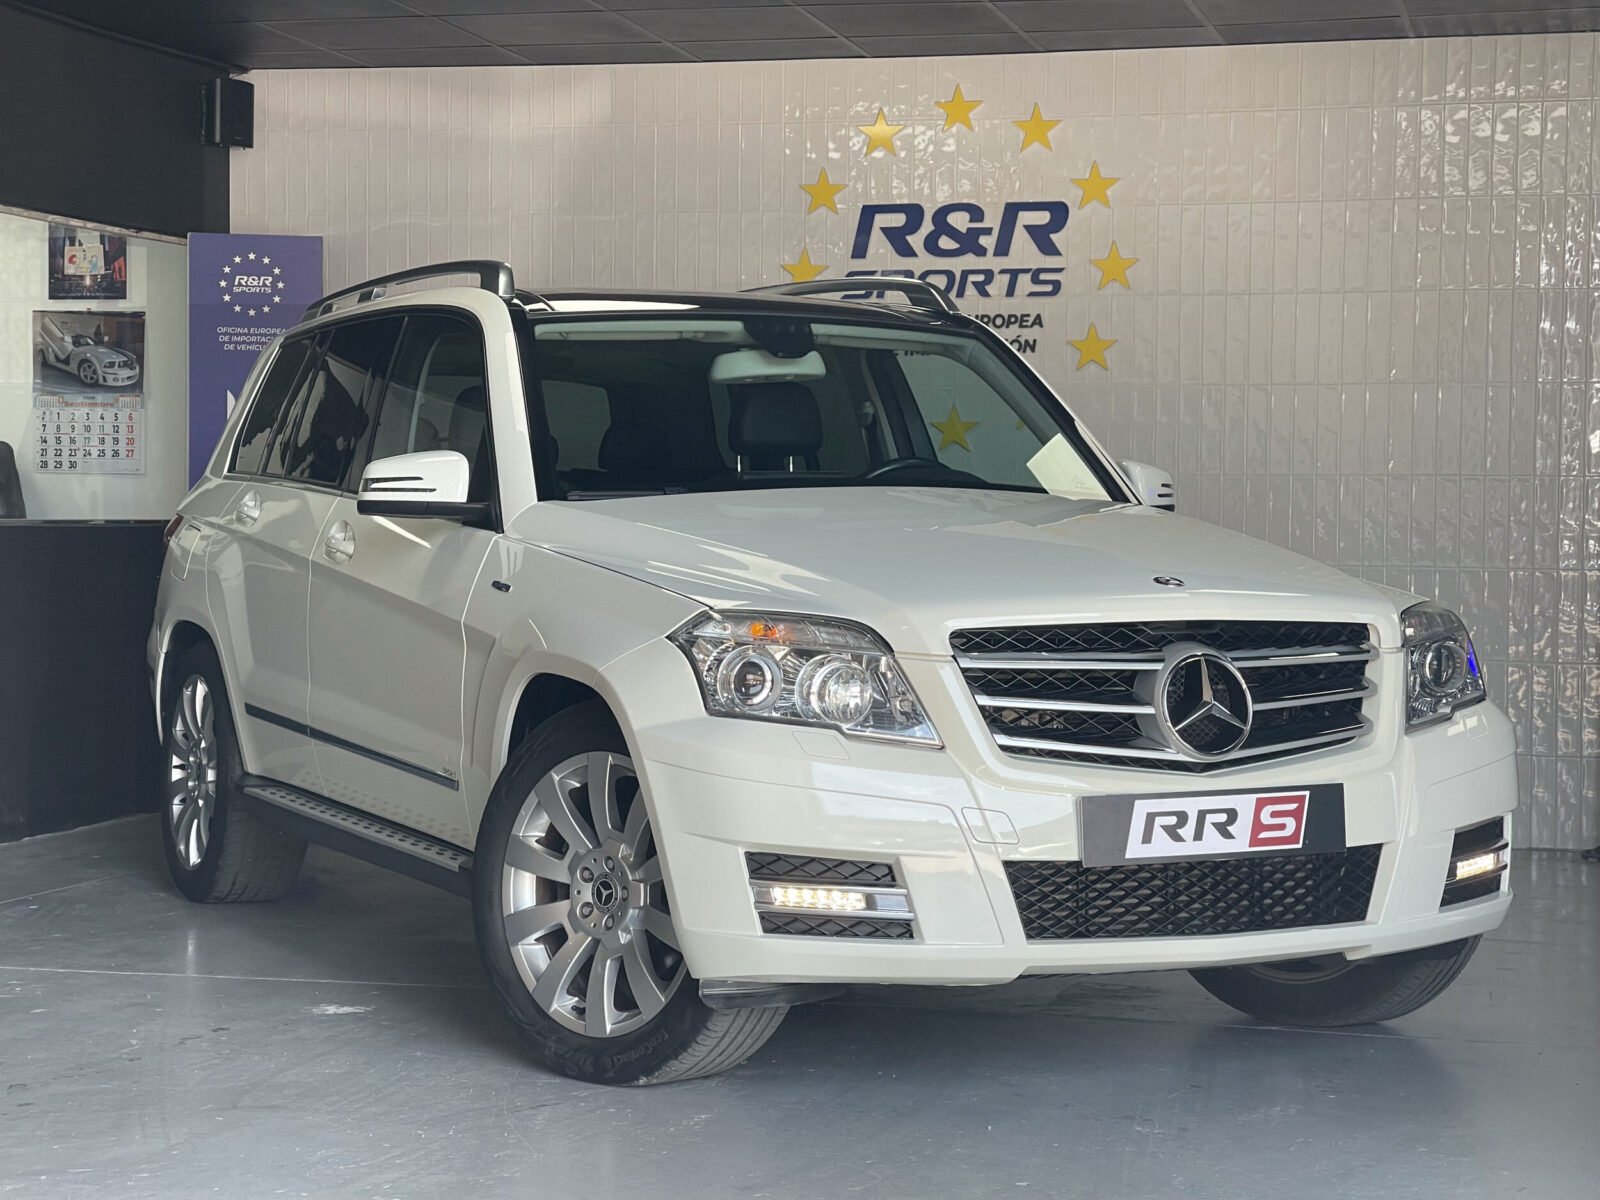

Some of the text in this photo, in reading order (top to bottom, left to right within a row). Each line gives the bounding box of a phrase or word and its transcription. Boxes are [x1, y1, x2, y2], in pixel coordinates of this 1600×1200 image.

[851, 201, 1069, 259] R&R
[235, 276, 273, 286] R&R
[231, 335, 273, 343] IMPORTAC
[224, 343, 235, 351] DE
[56, 413, 133, 421] 1 2 3 4 5 6
[42, 425, 134, 433] 7 8 9 10 11 12 13
[40, 437, 135, 445] 14 15 16 17 18 19 20
[40, 449, 134, 457] 21 22 23 24 25 26 27
[40, 460, 77, 469] 28 29 30
